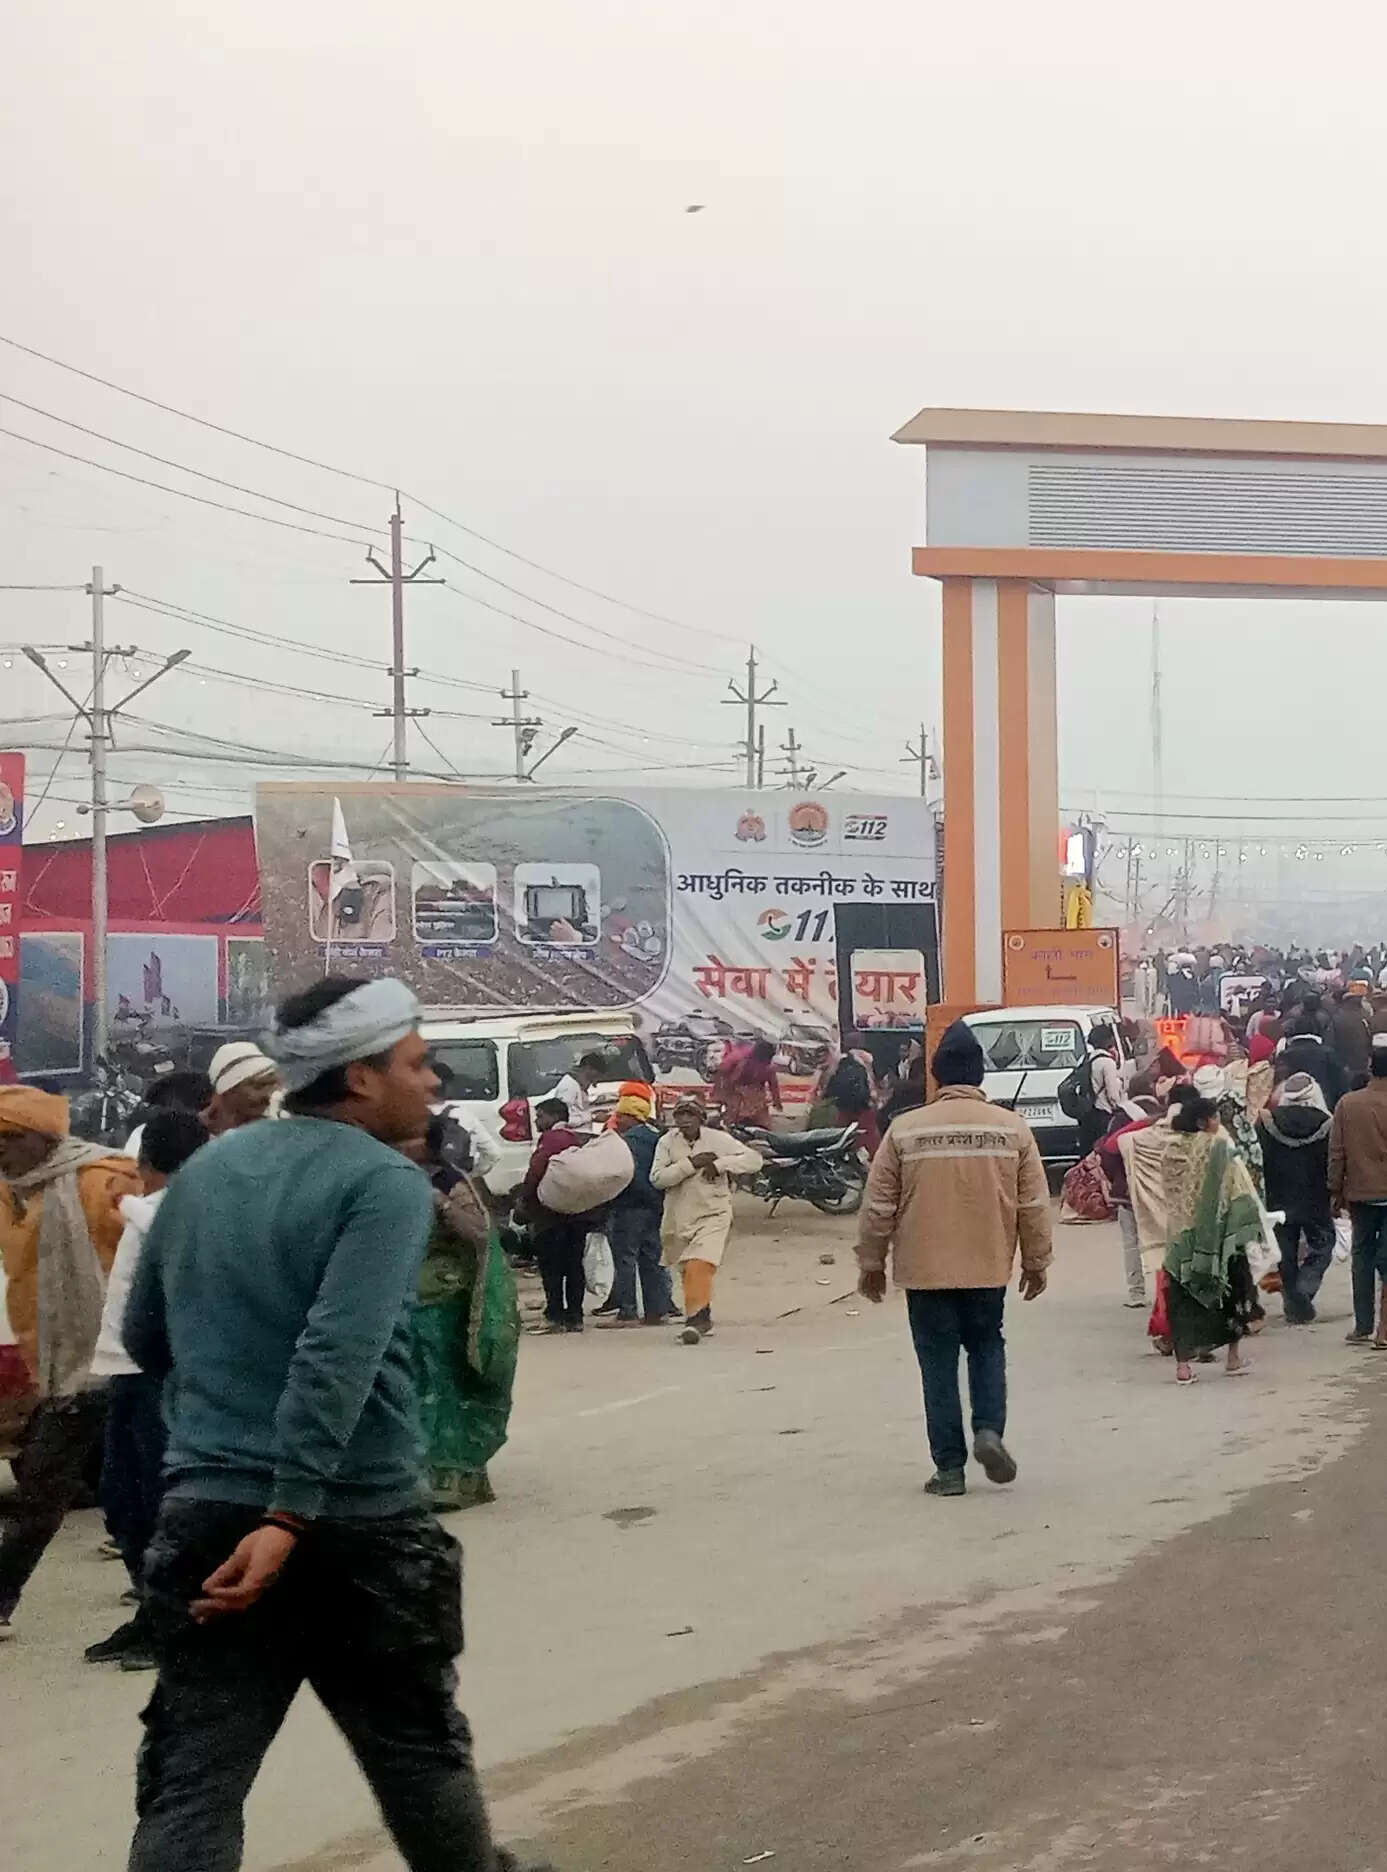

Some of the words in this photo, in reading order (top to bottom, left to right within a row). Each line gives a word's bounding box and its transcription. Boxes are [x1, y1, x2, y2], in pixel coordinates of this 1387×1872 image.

[859, 821, 887, 836] 112
[677, 869, 768, 900] आधुनिक
[773, 871, 856, 897] तकनीक
[861, 873, 883, 898] के
[891, 880, 937, 899] साथ
[794, 909, 835, 942] 11
[692, 954, 772, 1000] सेवा
[782, 956, 816, 1000] में
[1054, 1033, 1072, 1045] 112
[946, 1132, 973, 1146] प्रदेश
